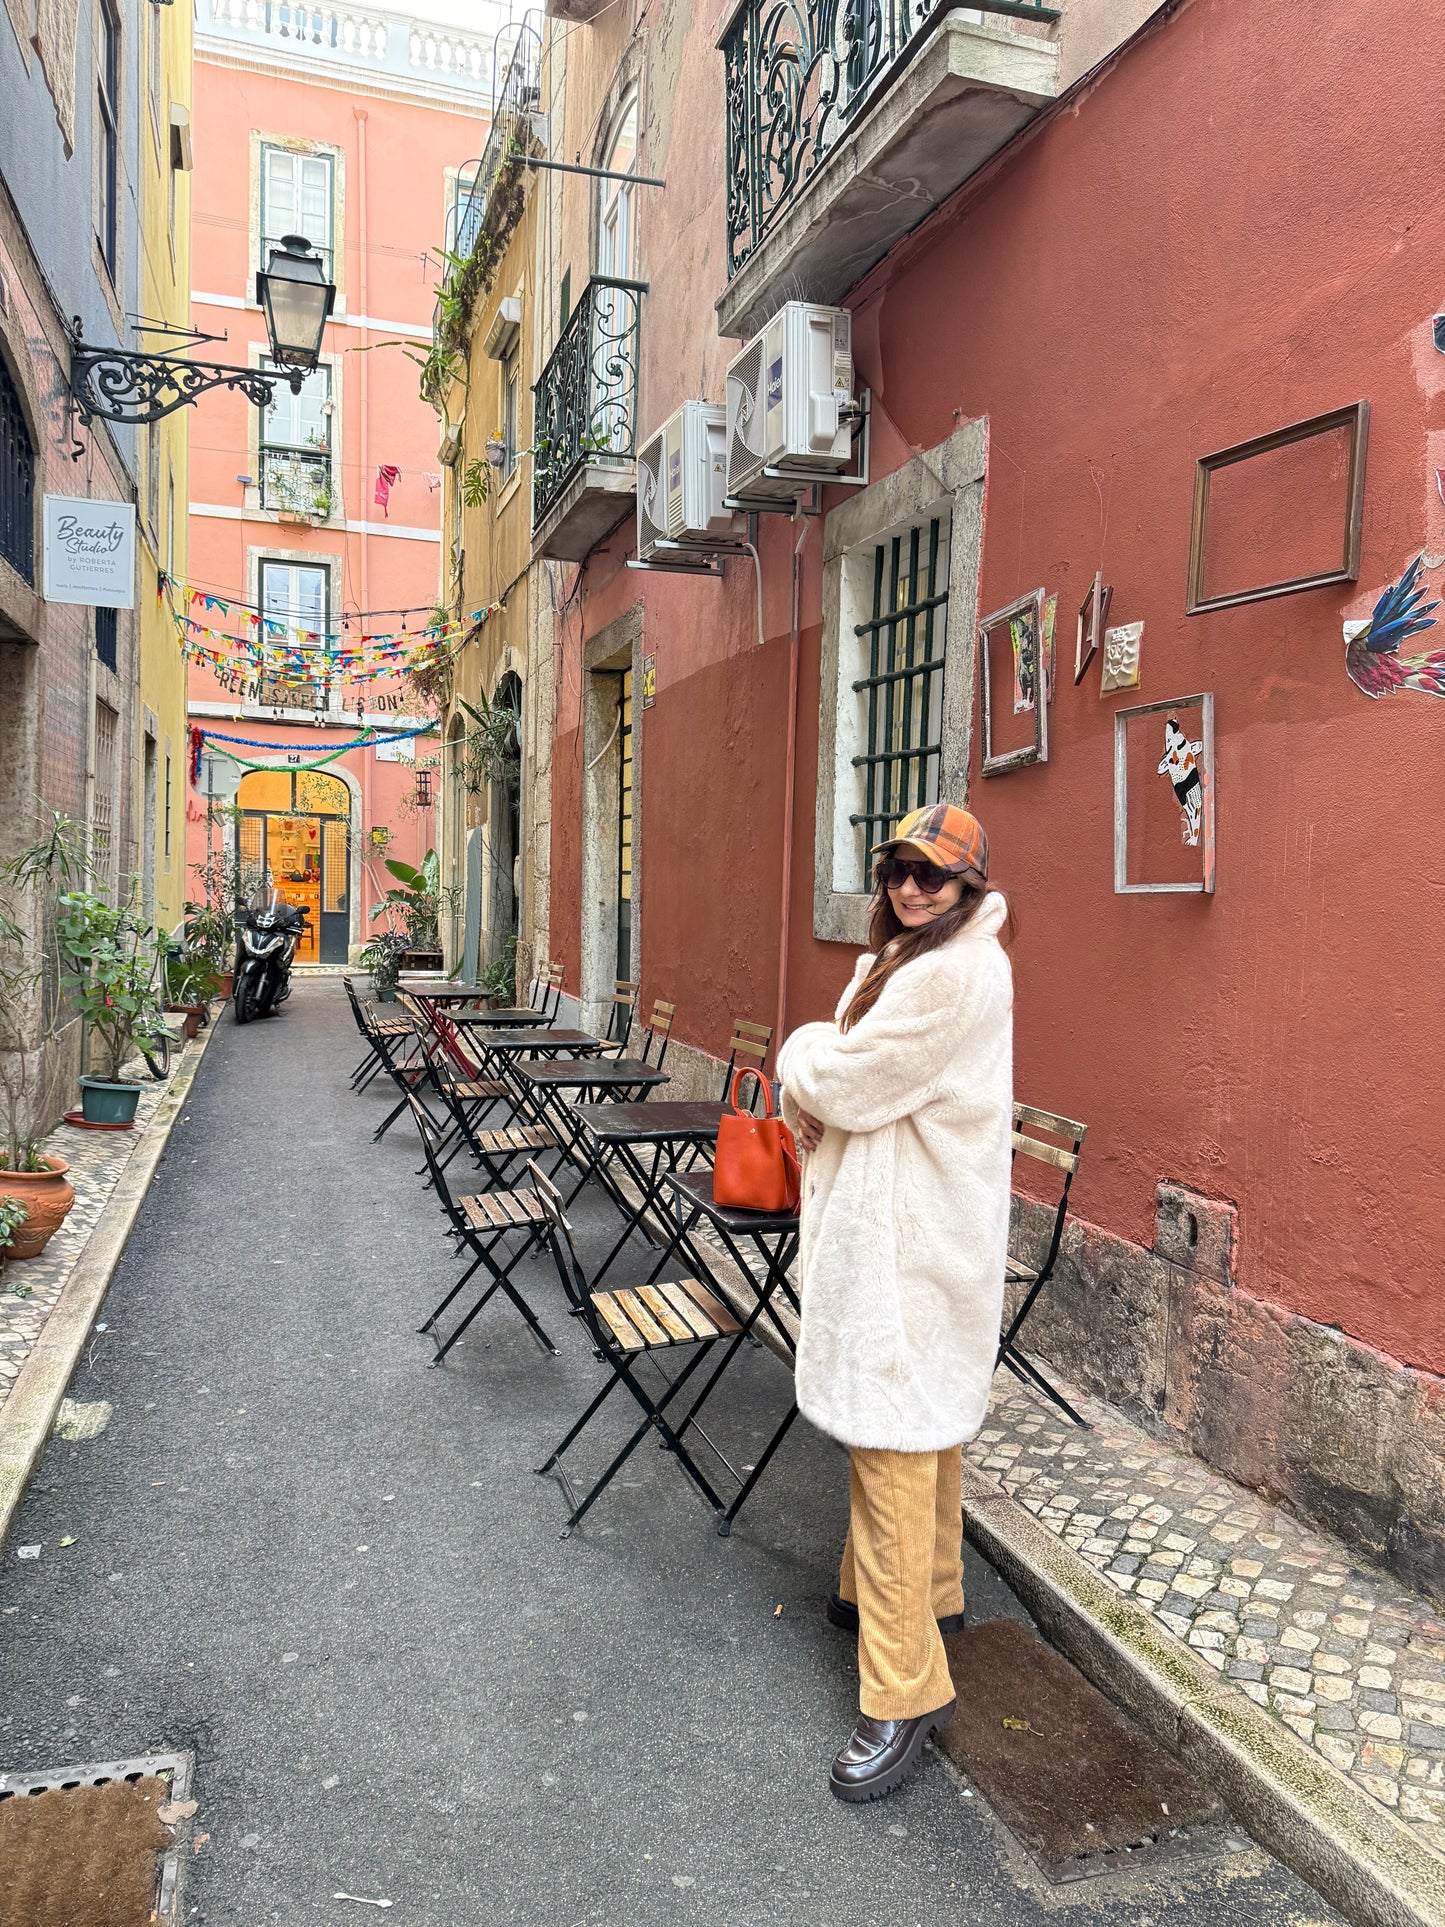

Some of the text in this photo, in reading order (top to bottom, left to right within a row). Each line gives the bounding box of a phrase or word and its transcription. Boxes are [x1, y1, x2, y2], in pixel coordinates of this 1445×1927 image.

[767, 375, 782, 397] Haier
[57, 515, 124, 552] Beauty
[65, 537, 108, 554] Studio
[69, 564, 115, 574] GUTIERRES
[79, 557, 117, 566] ROBERTA
[342, 694, 398, 713] LISON
